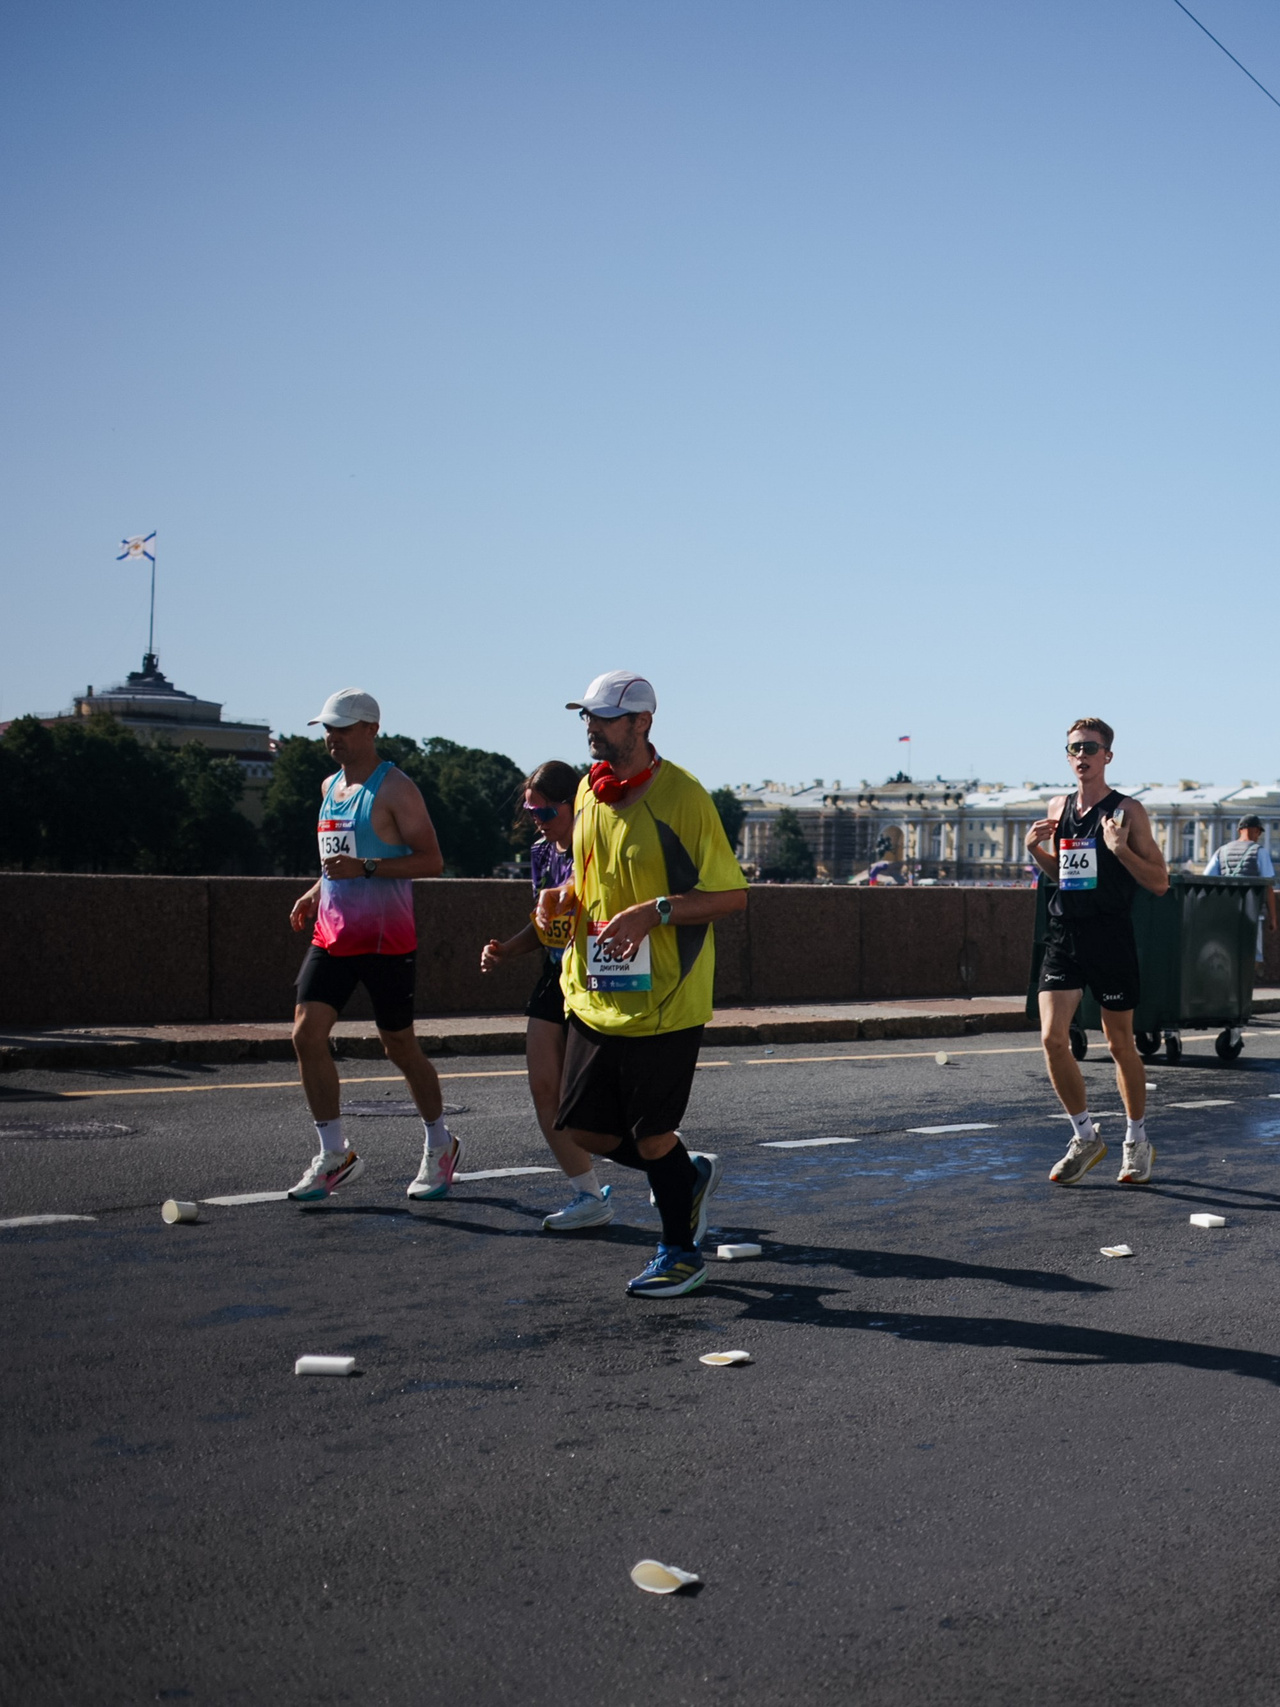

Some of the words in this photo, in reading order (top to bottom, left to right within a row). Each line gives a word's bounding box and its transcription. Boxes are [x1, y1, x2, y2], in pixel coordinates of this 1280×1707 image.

[321, 835, 351, 854] 1534
[1059, 853, 1089, 869] 246
[592, 942, 640, 963] 257
[599, 963, 631, 972] ДМИТРИЙ
[591, 976, 599, 989] B
